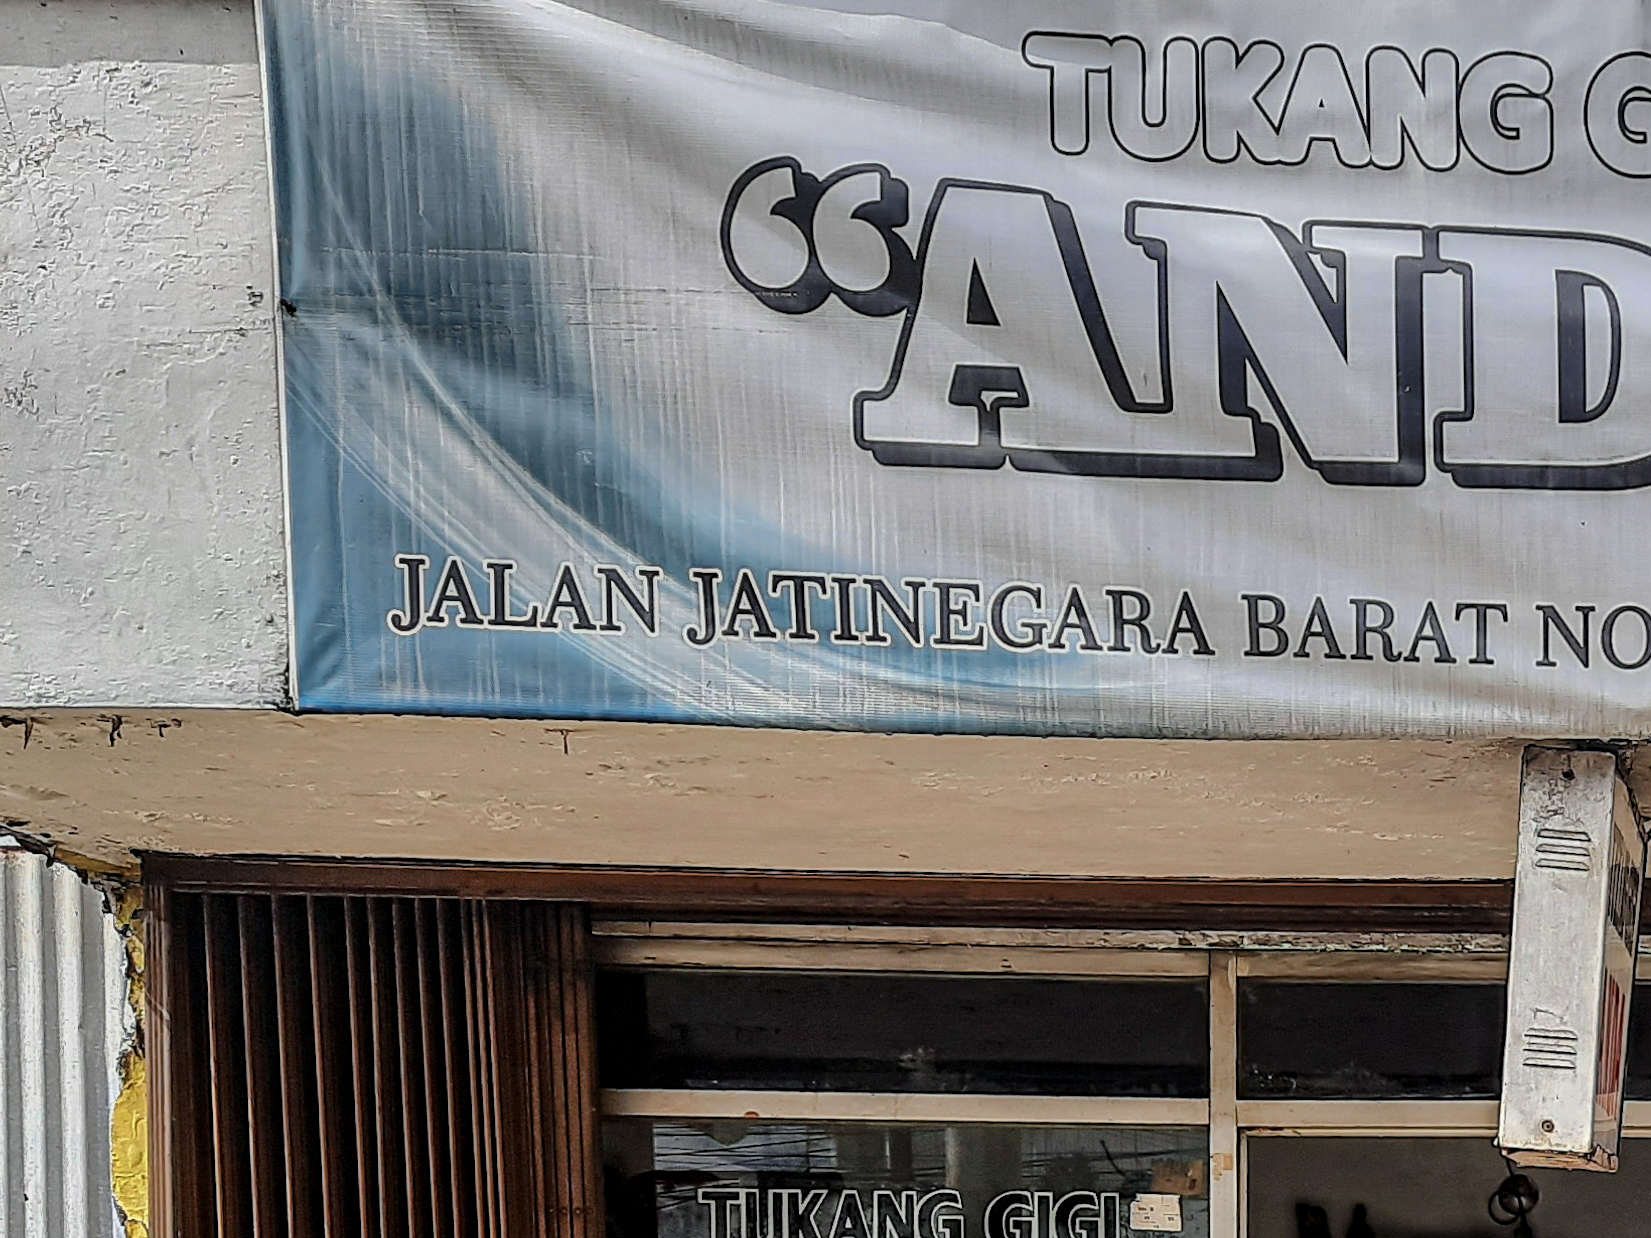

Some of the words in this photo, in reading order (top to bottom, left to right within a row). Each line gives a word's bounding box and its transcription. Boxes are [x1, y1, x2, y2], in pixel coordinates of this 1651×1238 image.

[1023, 30, 1554, 175] TUKANG
[388, 554, 661, 638] JALAN
[686, 566, 1216, 660] JATINEGARA
[1242, 593, 1509, 668] BARAT
